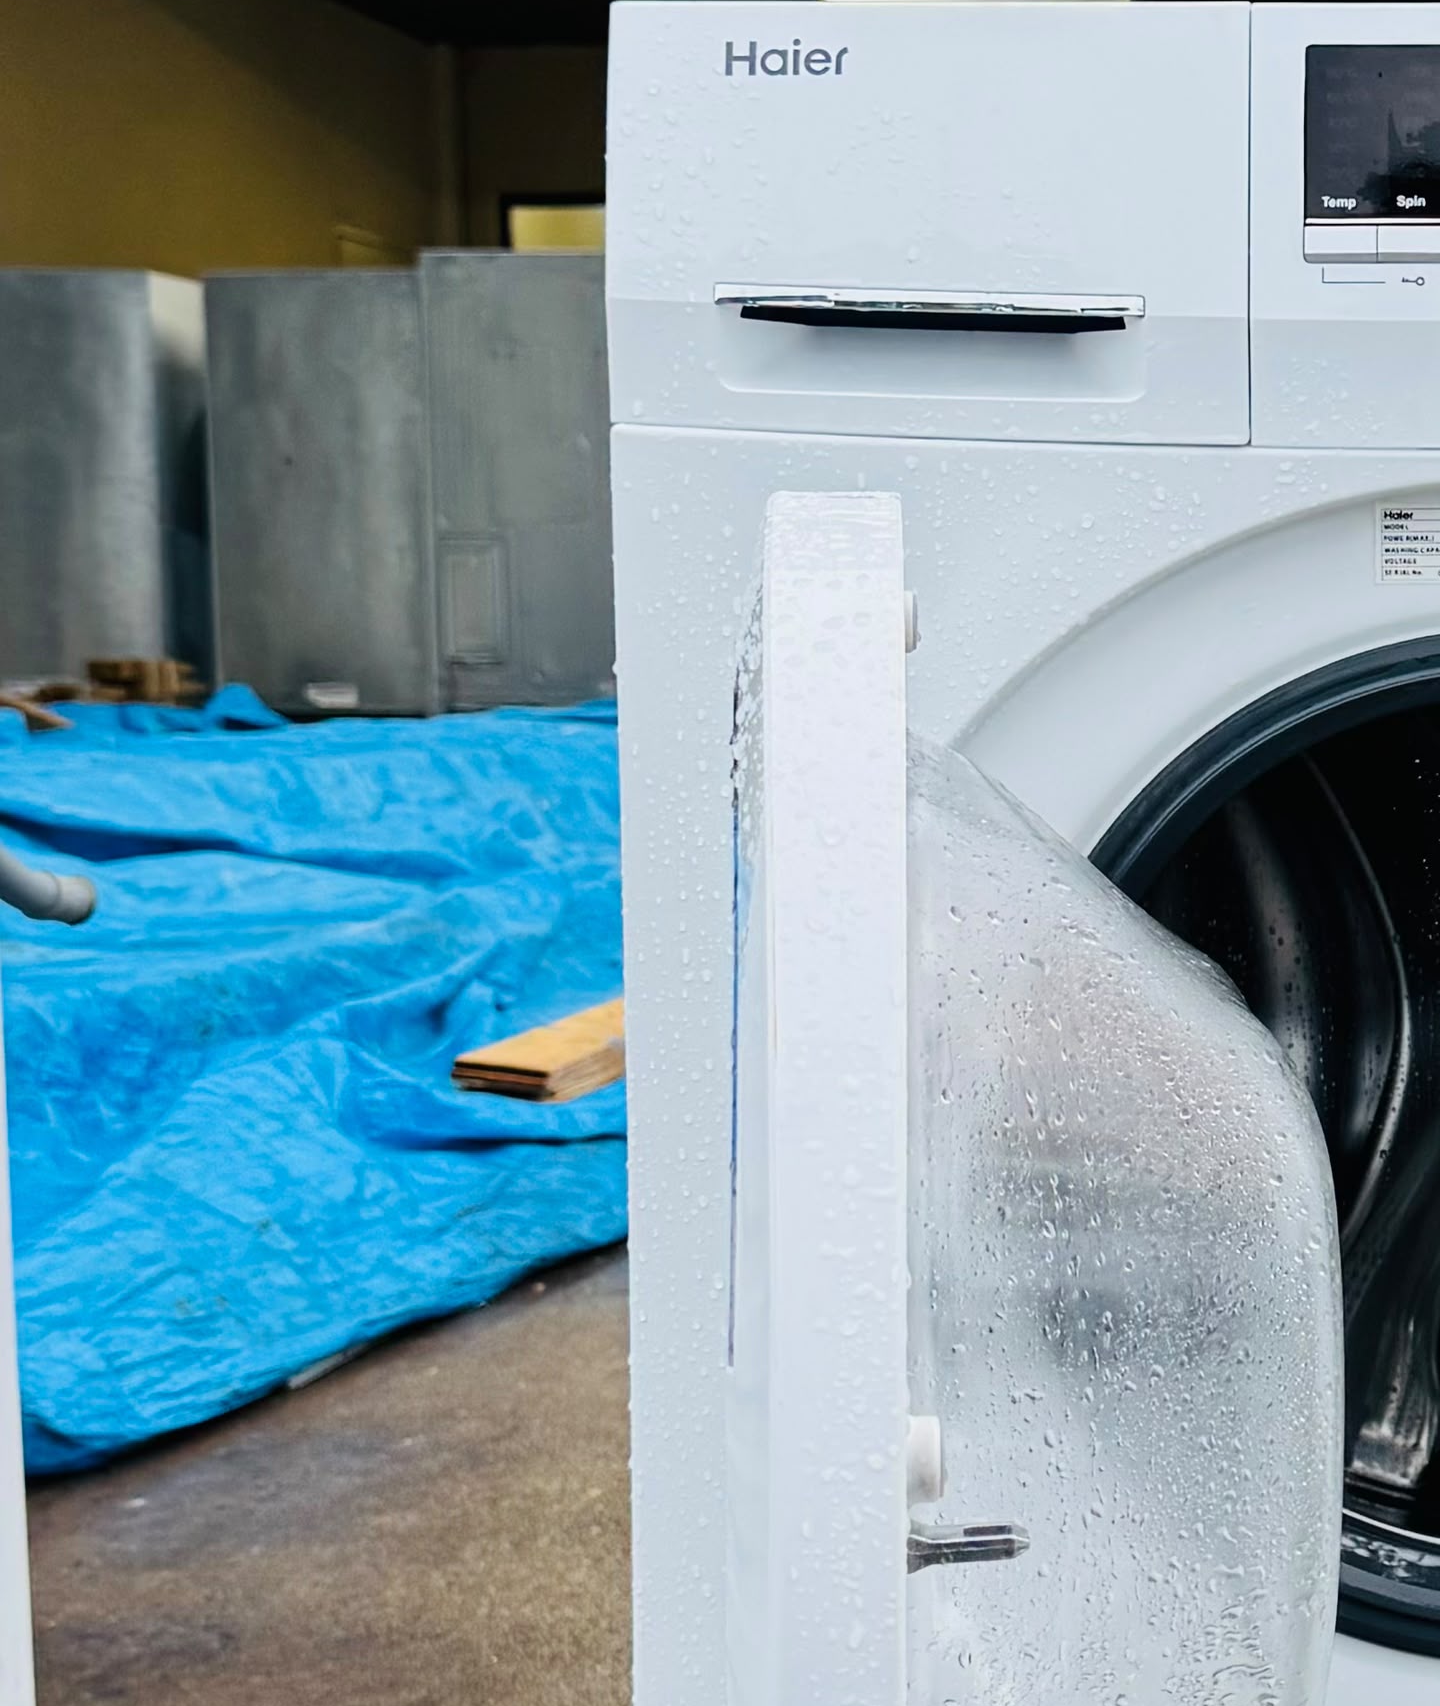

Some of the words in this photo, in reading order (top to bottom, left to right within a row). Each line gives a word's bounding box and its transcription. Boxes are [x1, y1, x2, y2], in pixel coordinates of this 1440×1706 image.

[725, 38, 849, 76] Haier
[1321, 196, 1356, 209] Temp
[1396, 195, 1426, 209] Spin
[1384, 510, 1414, 520] Haier
